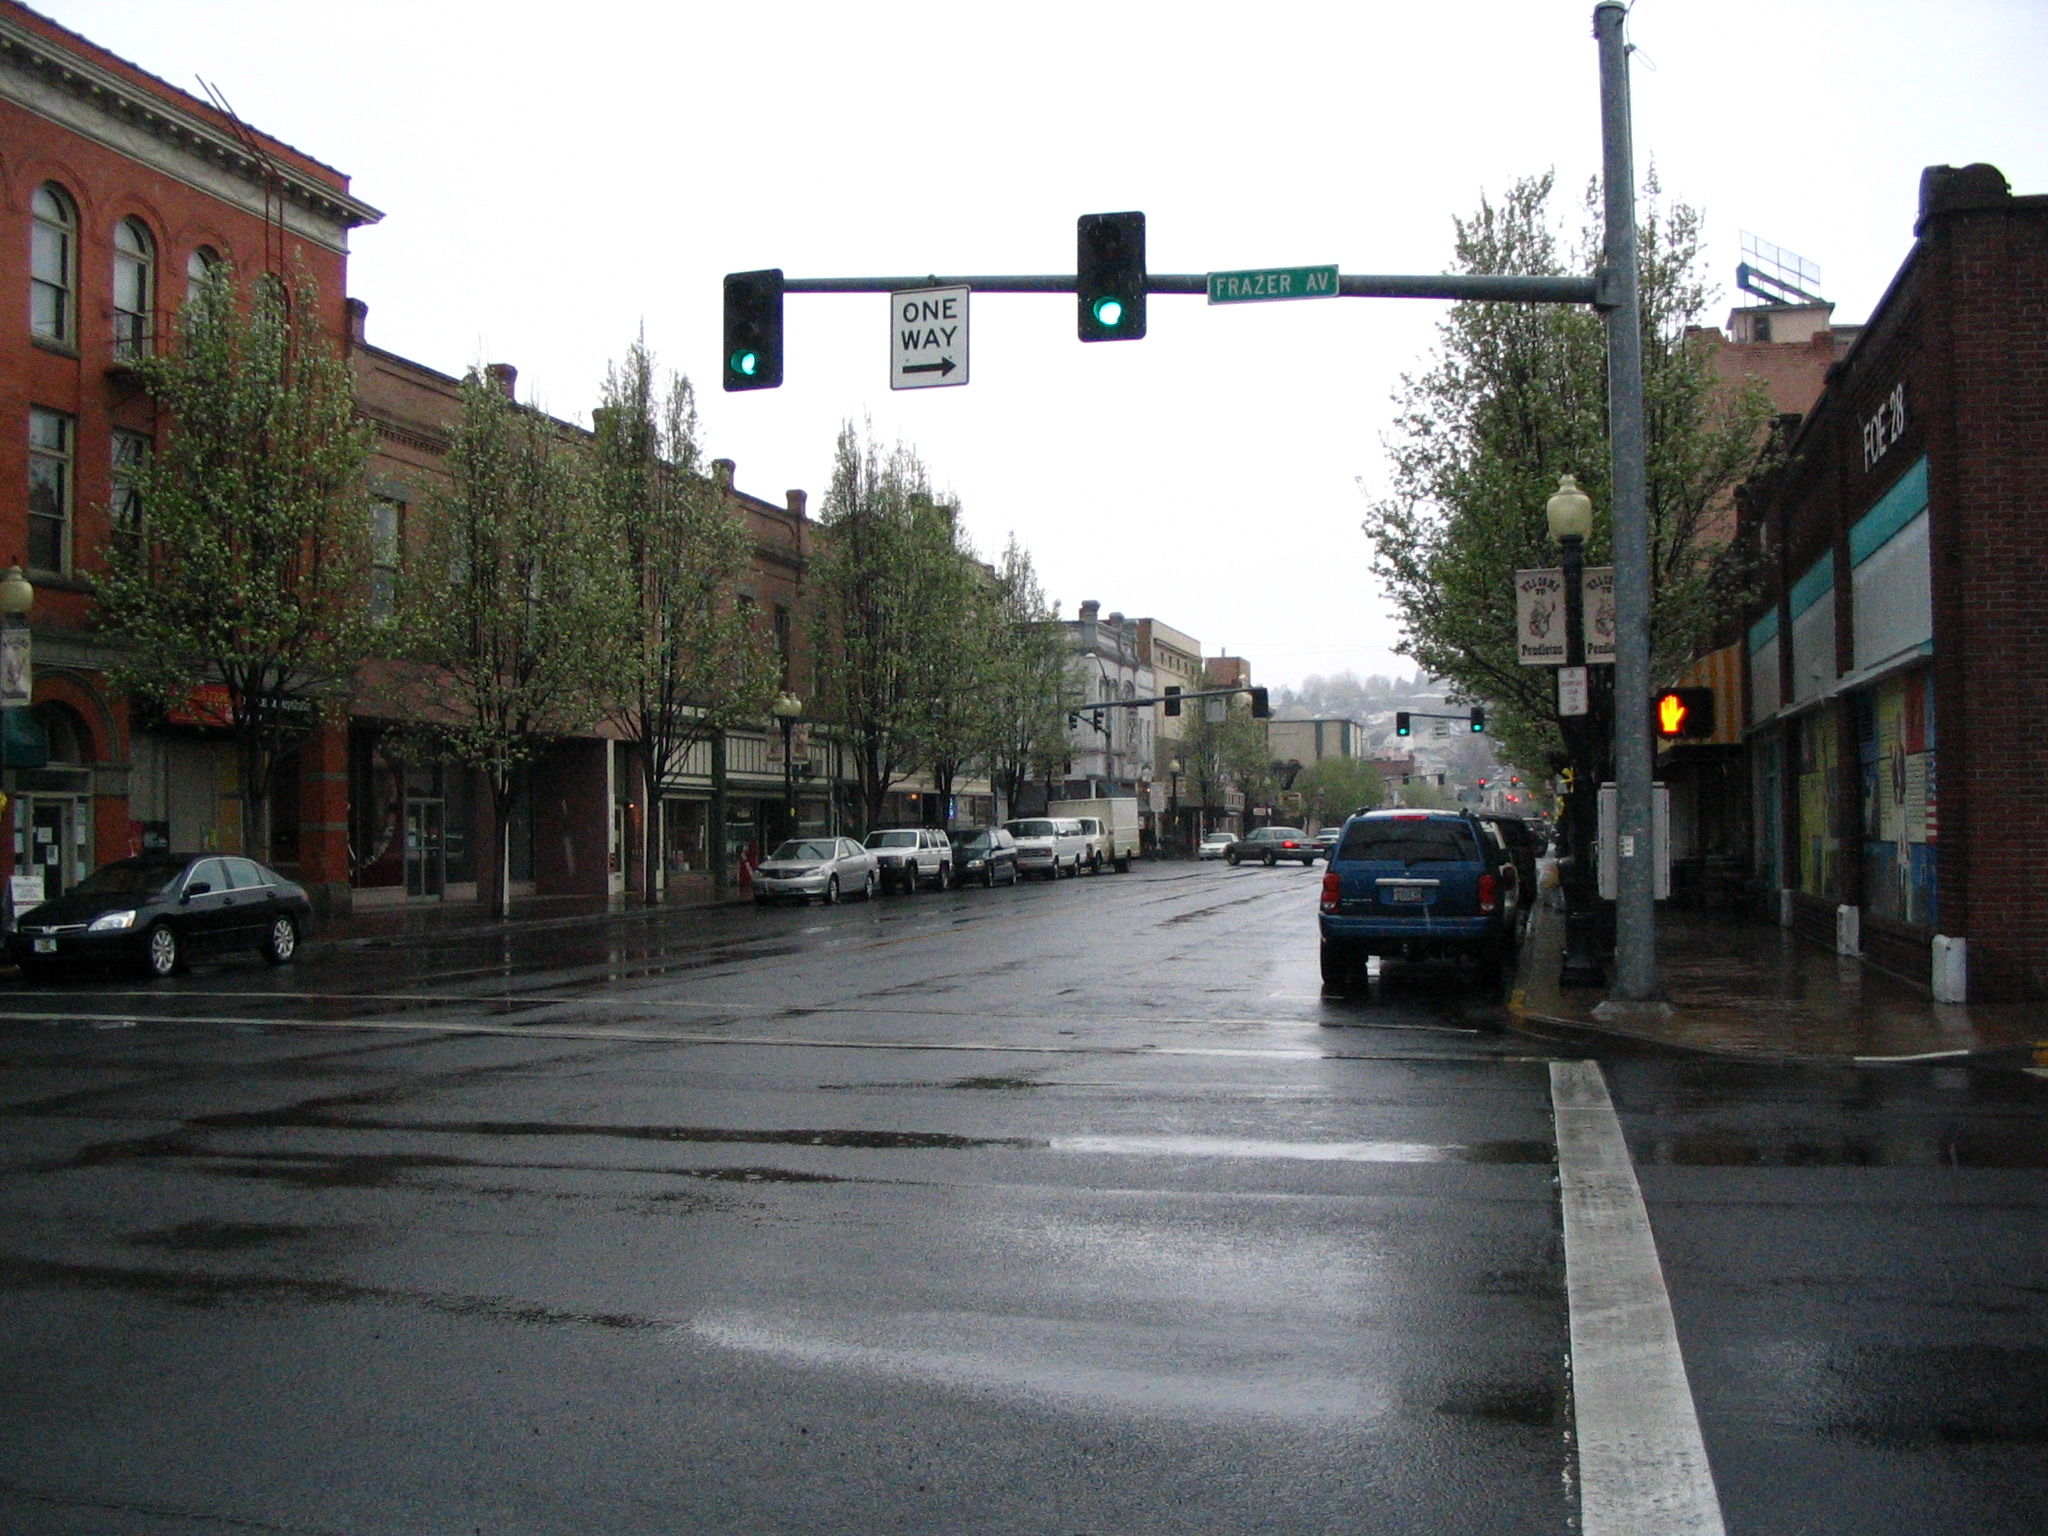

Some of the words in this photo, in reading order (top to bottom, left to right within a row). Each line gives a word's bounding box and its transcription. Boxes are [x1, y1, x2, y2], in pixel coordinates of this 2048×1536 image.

[1216, 274, 1291, 297] FRAZER
[1306, 271, 1329, 292] AV
[903, 298, 957, 323] ONE
[901, 325, 958, 351] WAY
[1863, 402, 1887, 473] FOE
[1889, 383, 1904, 444] 28
